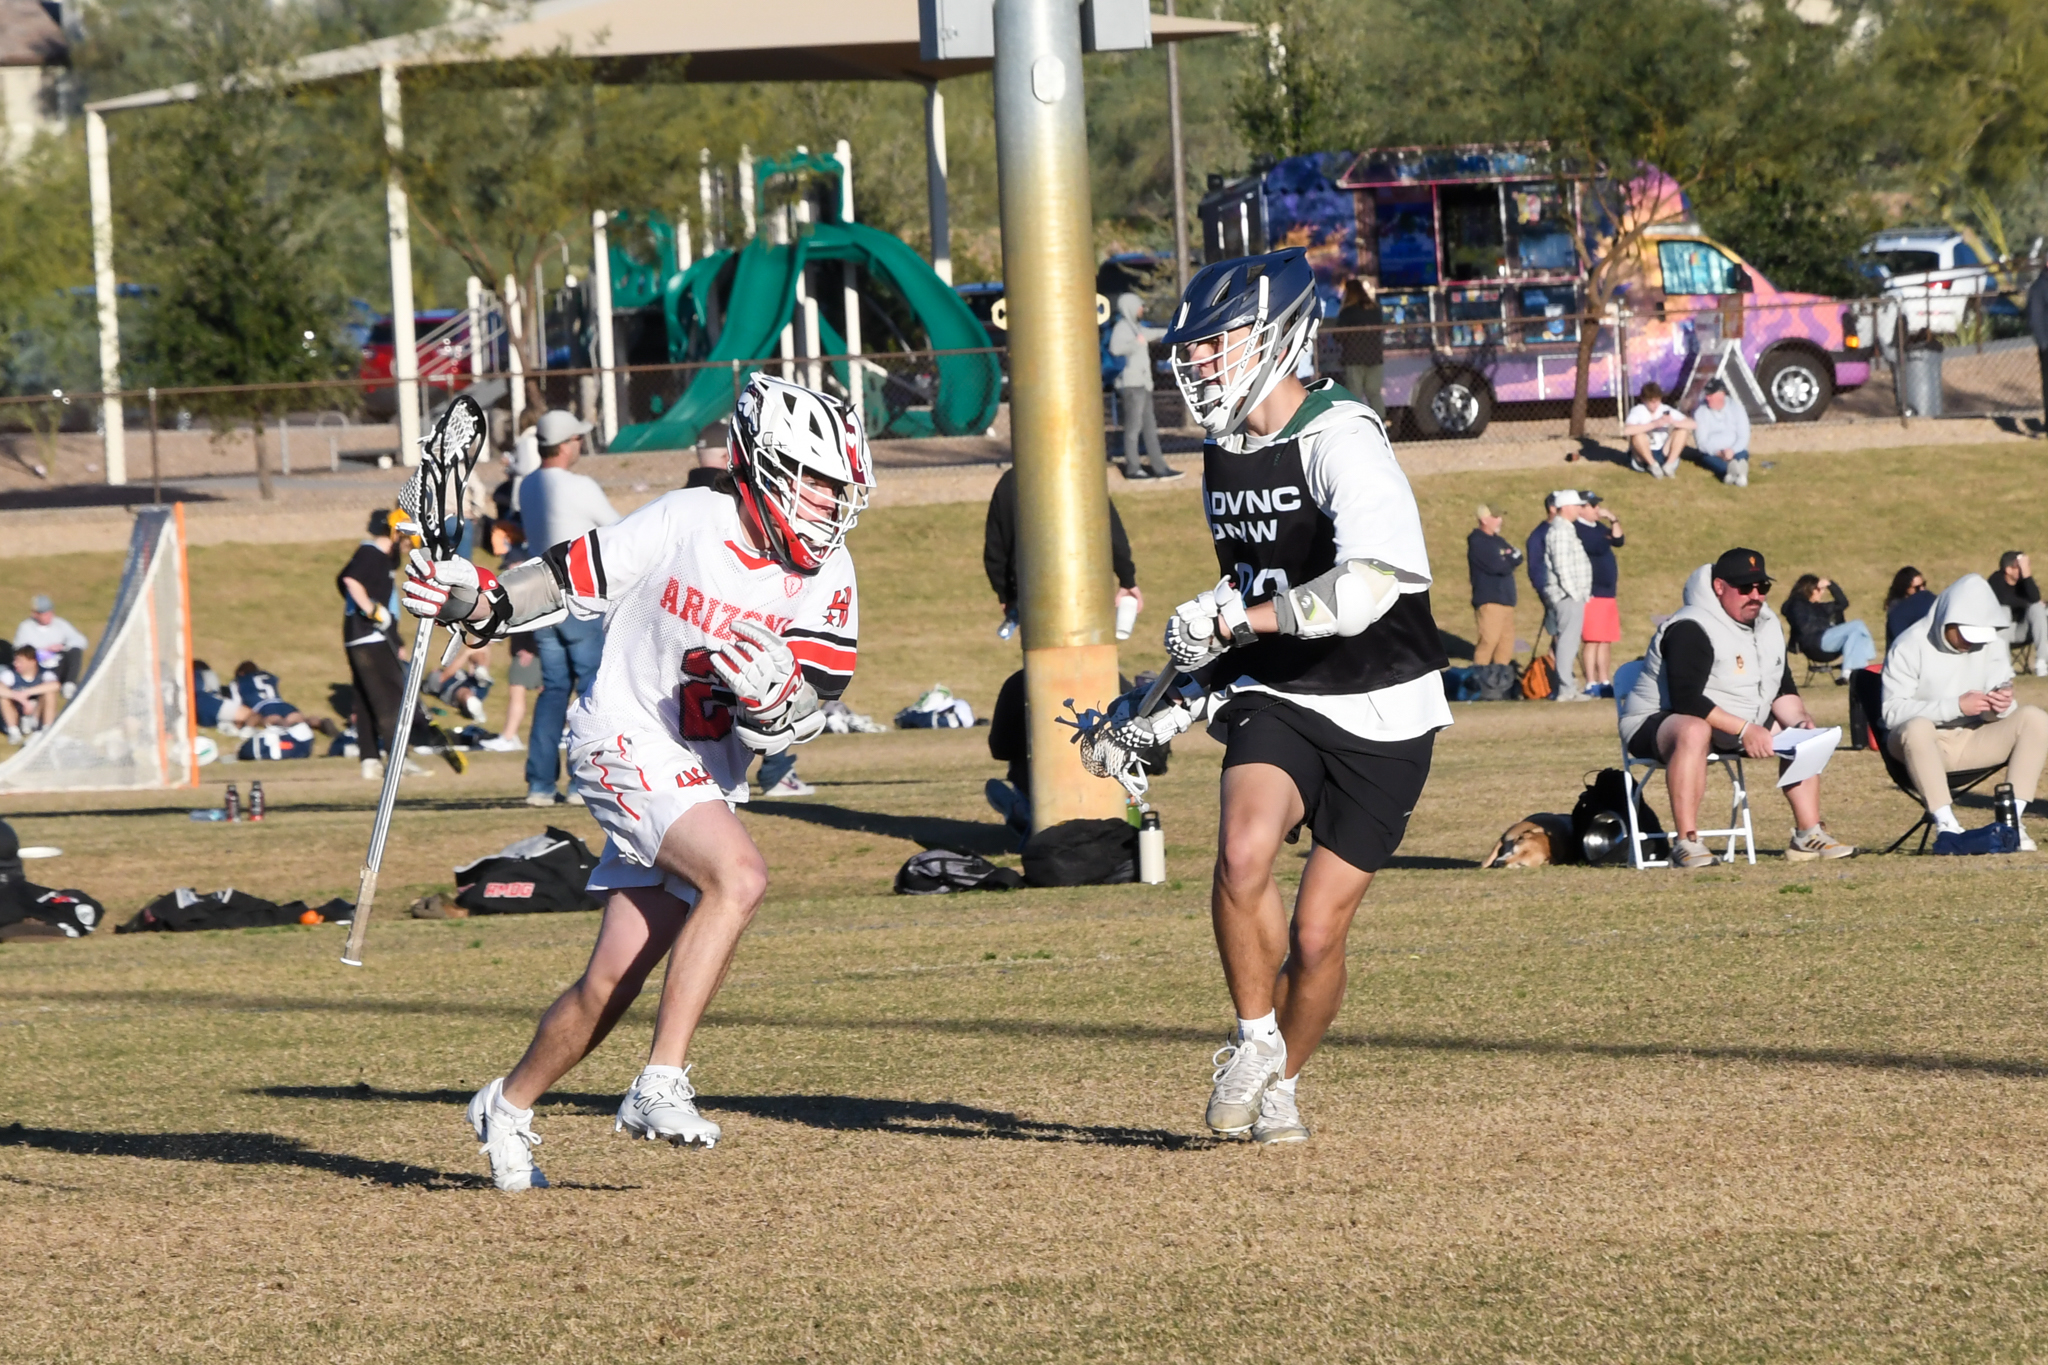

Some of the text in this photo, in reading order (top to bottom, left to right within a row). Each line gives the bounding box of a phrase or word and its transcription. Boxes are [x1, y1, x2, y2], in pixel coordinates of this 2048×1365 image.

[1209, 486, 1302, 516] DVNC
[660, 576, 794, 642] ARIZN
[253, 674, 277, 700] 5
